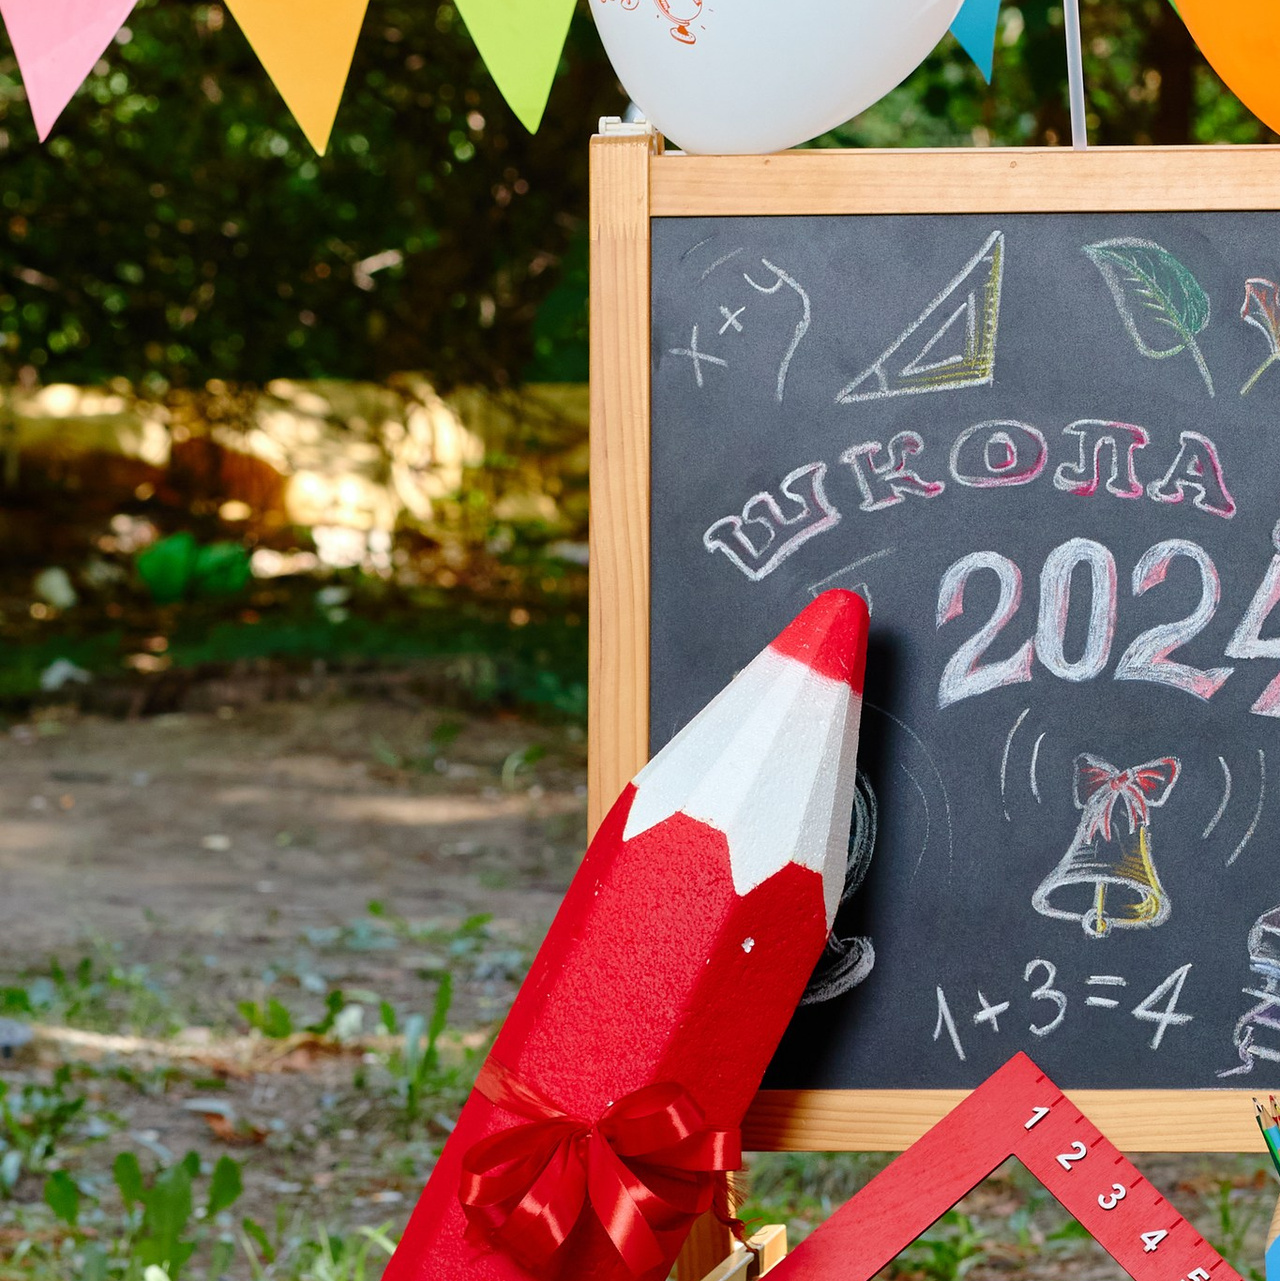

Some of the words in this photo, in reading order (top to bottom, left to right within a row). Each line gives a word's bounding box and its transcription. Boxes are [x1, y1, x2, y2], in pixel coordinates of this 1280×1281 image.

[1024, 1106, 1050, 1131] 1
[1056, 1141, 1087, 1171] 2
[1098, 1183, 1126, 1210] 3
[1140, 1229, 1168, 1253] 4
